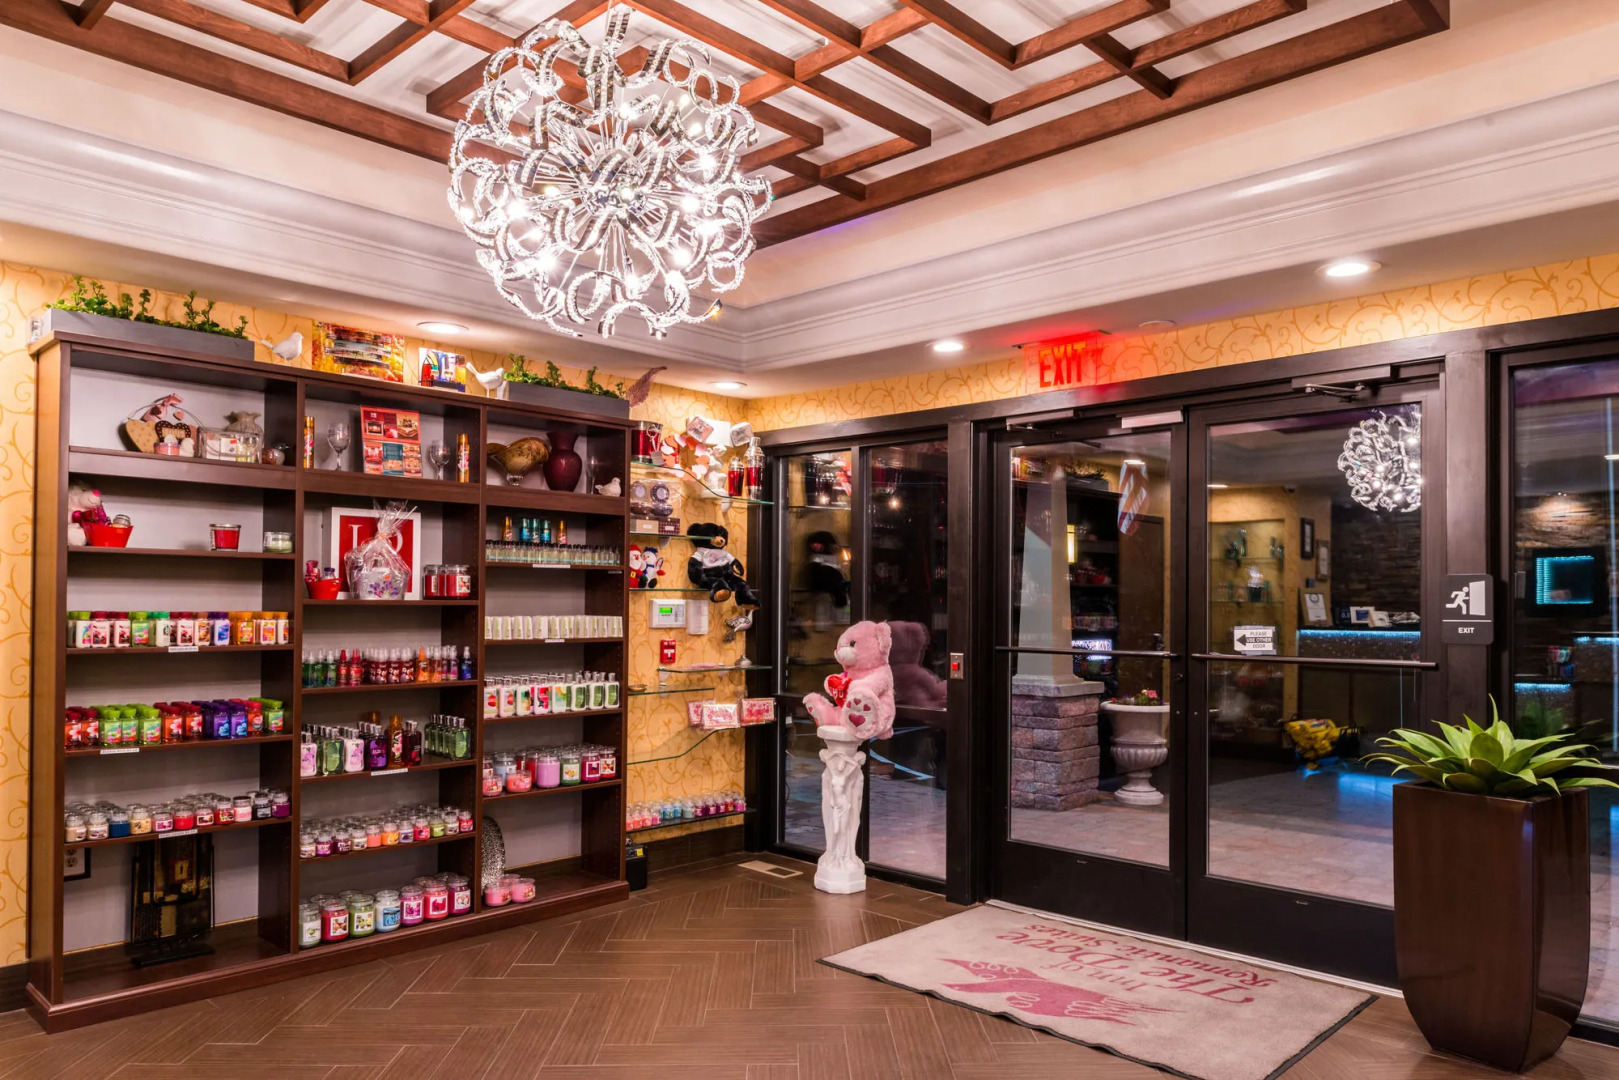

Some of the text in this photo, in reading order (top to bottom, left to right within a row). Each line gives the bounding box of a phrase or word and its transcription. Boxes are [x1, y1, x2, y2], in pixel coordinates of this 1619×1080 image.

[1038, 341, 1087, 388] EXIT
[996, 931, 1254, 1003] The Dove
[1024, 924, 1278, 988] Romantic Suites
[1040, 959, 1148, 991] Inn of
